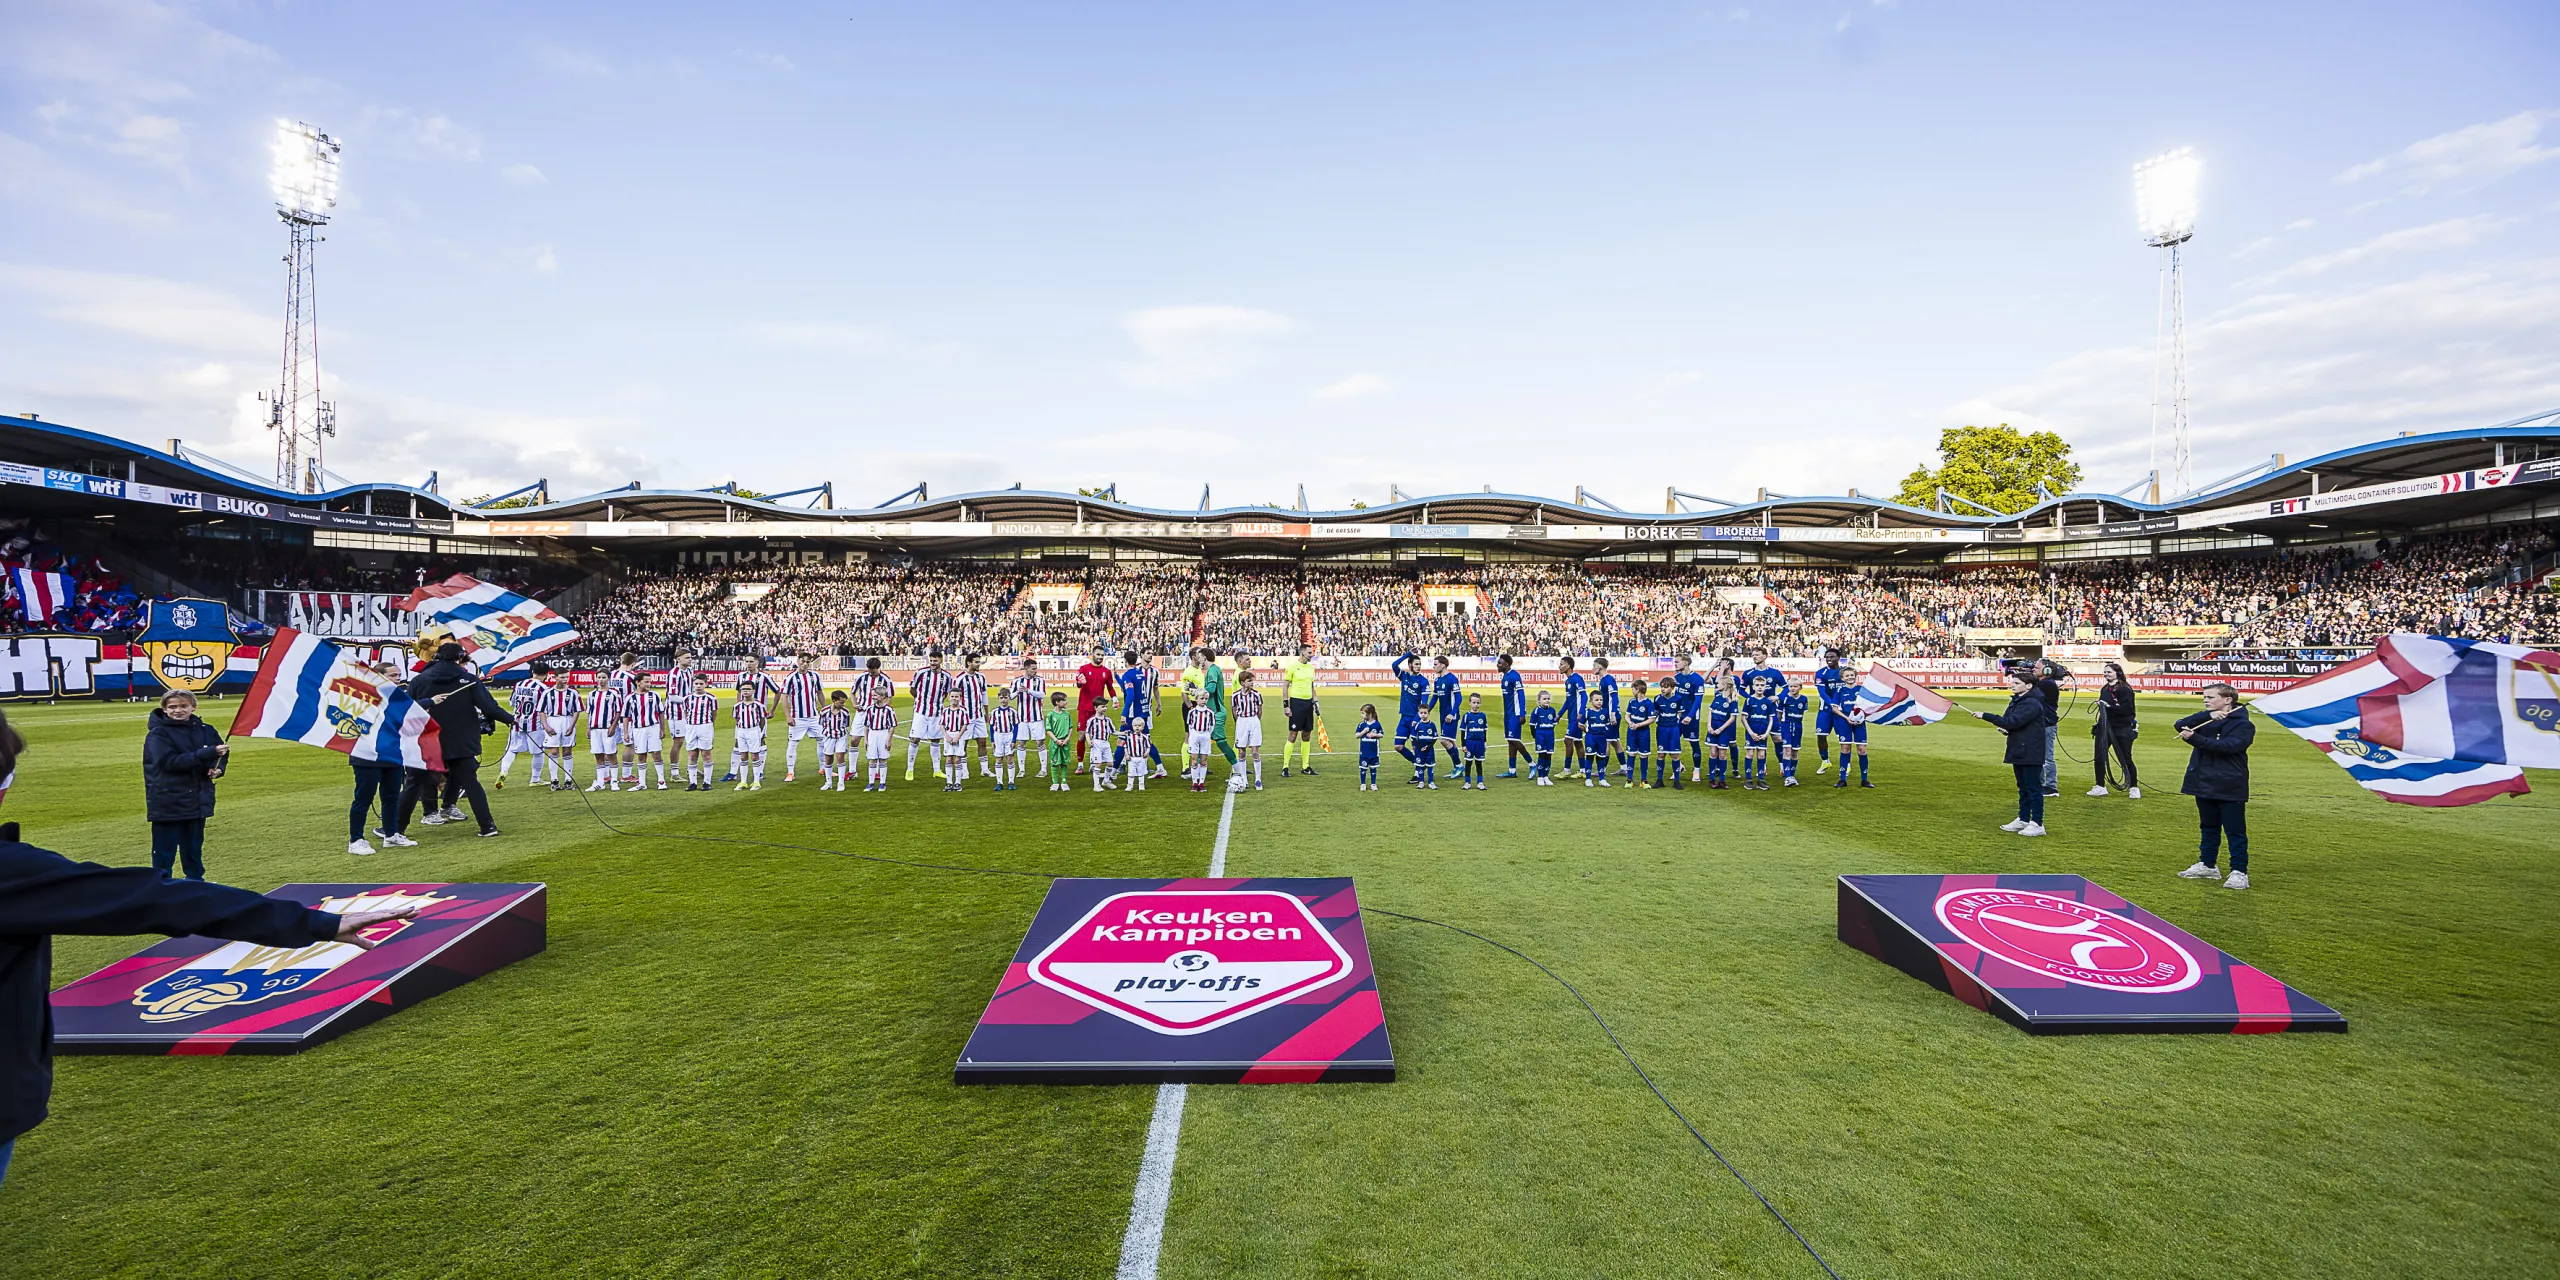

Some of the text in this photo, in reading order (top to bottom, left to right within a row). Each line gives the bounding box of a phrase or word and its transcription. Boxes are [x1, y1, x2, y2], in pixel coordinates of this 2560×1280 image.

[47, 470, 82, 483] SKD
[88, 479, 121, 496] wtf
[2314, 493, 2357, 506] MULTIMODAL
[2357, 489, 2396, 500] CONTAINER
[2396, 481, 2438, 494] SOLUTIONS
[170, 492, 198, 507] wtf
[288, 511, 321, 521] Van Mossel
[332, 516, 345, 524] Van
[996, 524, 1043, 534] INDICIA
[1232, 523, 1284, 534] VALERES
[1401, 525, 1457, 536] De Ruwenberg
[1627, 527, 1678, 539] BOREK
[1715, 527, 1766, 536] BROEREN
[1856, 528, 1933, 541] RaKo-Printing.nl
[1429, 584, 1470, 596] AVEC
[290, 592, 388, 636] ALLES
[2136, 628, 2170, 637] DHL
[2184, 626, 2221, 636] DHL
[1887, 659, 1924, 669] Coffee
[2169, 662, 2221, 672] Van Mossel
[2228, 663, 2287, 673] Van Mossel
[2296, 663, 2322, 674] Van
[1256, 672, 1280, 681] DENK AAN
[1365, 672, 1375, 681] WIT
[1376, 672, 1383, 681] EN
[1462, 672, 1480, 681] WILLEM
[1542, 673, 1558, 682] ALLEN
[1929, 674, 1943, 683] DENK
[1943, 674, 1953, 683] AAN
[1960, 674, 1974, 683] ROEM
[1981, 674, 1998, 683] GLORIE
[2143, 678, 2155, 687] WIT
[2156, 678, 2164, 687] EN
[2164, 678, 2183, 688] BLAUW
[2183, 678, 2201, 688] ONZER
[2230, 680, 2252, 689] KLEURT
[2253, 680, 2277, 690] WILLEM
[515, 700, 535, 716] 20
[2371, 751, 2389, 762] 96
[1952, 894, 2020, 921] ALMERE
[2034, 897, 2113, 923] CITY
[1125, 908, 1273, 925] Keuken
[1091, 923, 1302, 945] Kampioen
[2044, 960, 2155, 985] FOOTBALL
[2149, 961, 2176, 982] CLUB
[167, 974, 203, 990] 18
[260, 973, 302, 992] 96
[1113, 974, 1262, 992] play-offs
